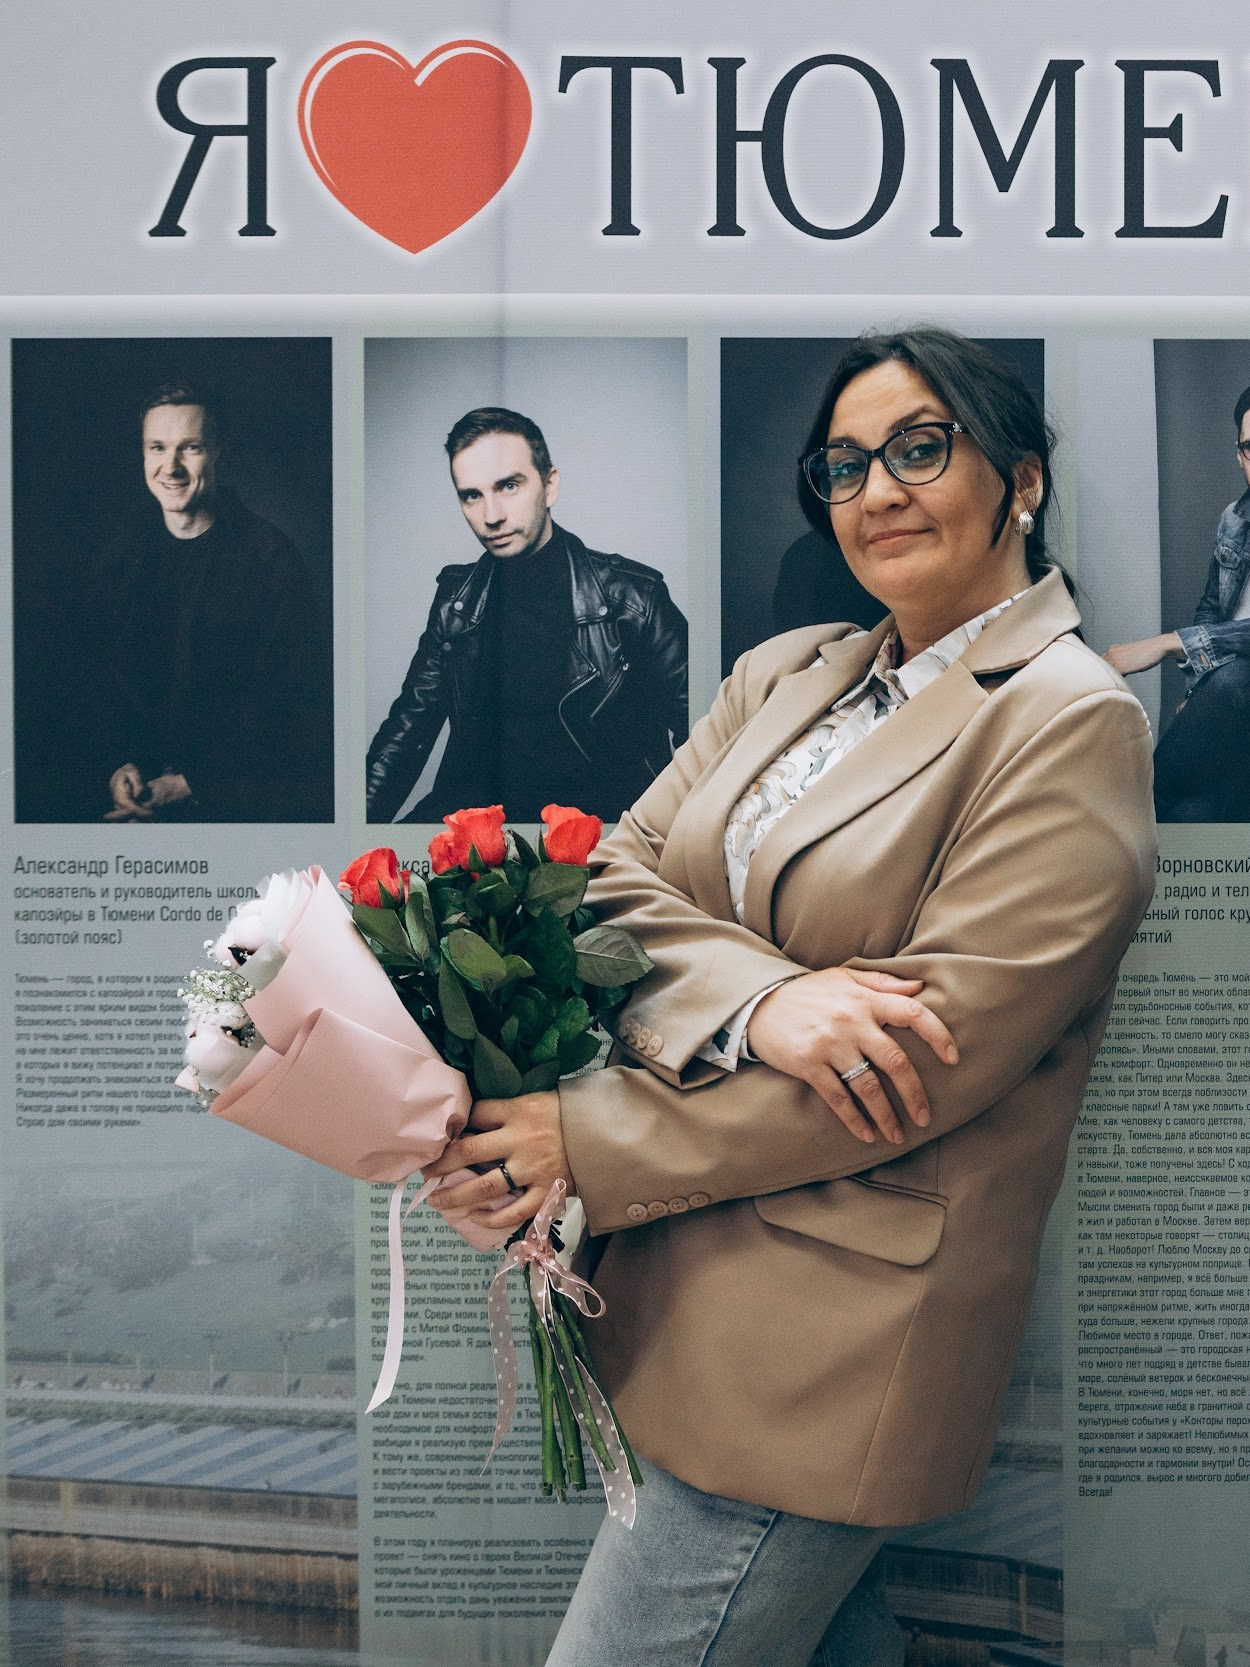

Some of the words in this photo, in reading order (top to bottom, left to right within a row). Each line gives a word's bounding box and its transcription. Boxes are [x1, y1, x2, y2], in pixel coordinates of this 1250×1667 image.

[147, 56, 277, 238] Я
[13, 855, 109, 879] Александр
[114, 855, 210, 879] Герасимов
[13, 885, 97, 899] основатель
[100, 885, 110, 899] и
[113, 885, 213, 903] руководитель
[1164, 886, 1207, 900] радио
[1211, 886, 1221, 897] и
[13, 904, 84, 926] капоэйры
[87, 908, 96, 922] в
[101, 904, 156, 922] Тюмени
[159, 904, 202, 922] Cordo
[206, 904, 223, 922] de
[1184, 908, 1225, 921] голос
[15, 929, 80, 948] (золотой
[83, 929, 123, 948] пояс)
[1117, 986, 1152, 999] первый
[1153, 988, 1176, 997] опыт
[1178, 988, 1190, 997] во
[1191, 988, 1224, 997] многих
[1077, 1115, 1101, 1127] Мне,
[1103, 1117, 1119, 1126] как
[1121, 1117, 1163, 1128] человеку
[1173, 1117, 1206, 1126] самого
[1207, 1117, 1247, 1127] детства,
[1077, 1201, 1111, 1212] Мысли
[1112, 1203, 1151, 1212] сменить
[1153, 1203, 1180, 1214] город
[1180, 1201, 1206, 1212] были
[1215, 1203, 1240, 1213] даже
[1077, 1318, 1099, 1328] куда
[1100, 1316, 1138, 1327] больше,
[1140, 1318, 1176, 1326] нежели
[1177, 1318, 1216, 1328] крупные
[1217, 1318, 1250, 1328] города.
[1078, 1329, 1122, 1340] Любимое
[1123, 1331, 1152, 1340] место
[1161, 1331, 1195, 1342] городе.
[1197, 1329, 1227, 1341] Ответ,
[1078, 1486, 1113, 1498] Всегда!
